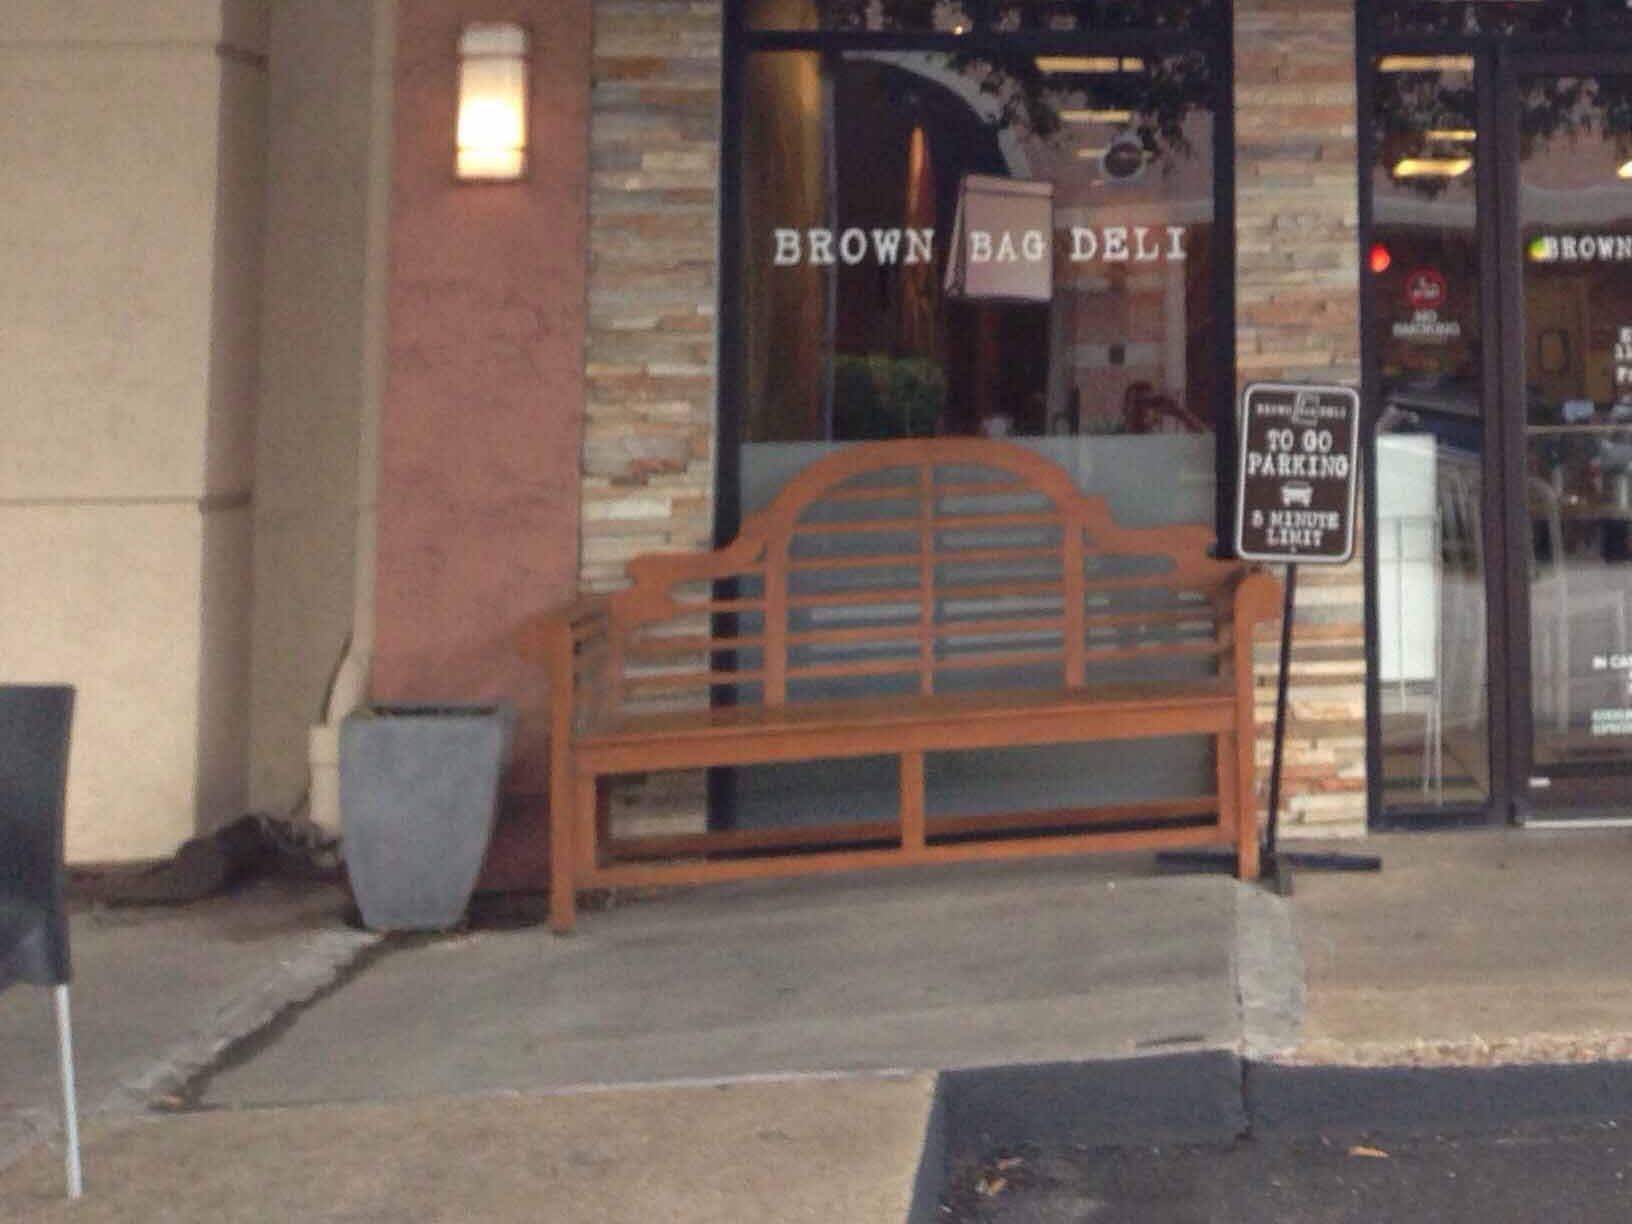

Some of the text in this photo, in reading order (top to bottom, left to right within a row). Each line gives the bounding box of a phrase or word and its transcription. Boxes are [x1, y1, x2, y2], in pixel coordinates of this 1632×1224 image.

[773, 226, 1188, 266] BROWN BAG DELI
[1267, 428, 1333, 453] TO GO
[1247, 452, 1349, 477] PARKING
[1270, 510, 1340, 530] MINUTE
[1265, 527, 1324, 547] LIMIT
